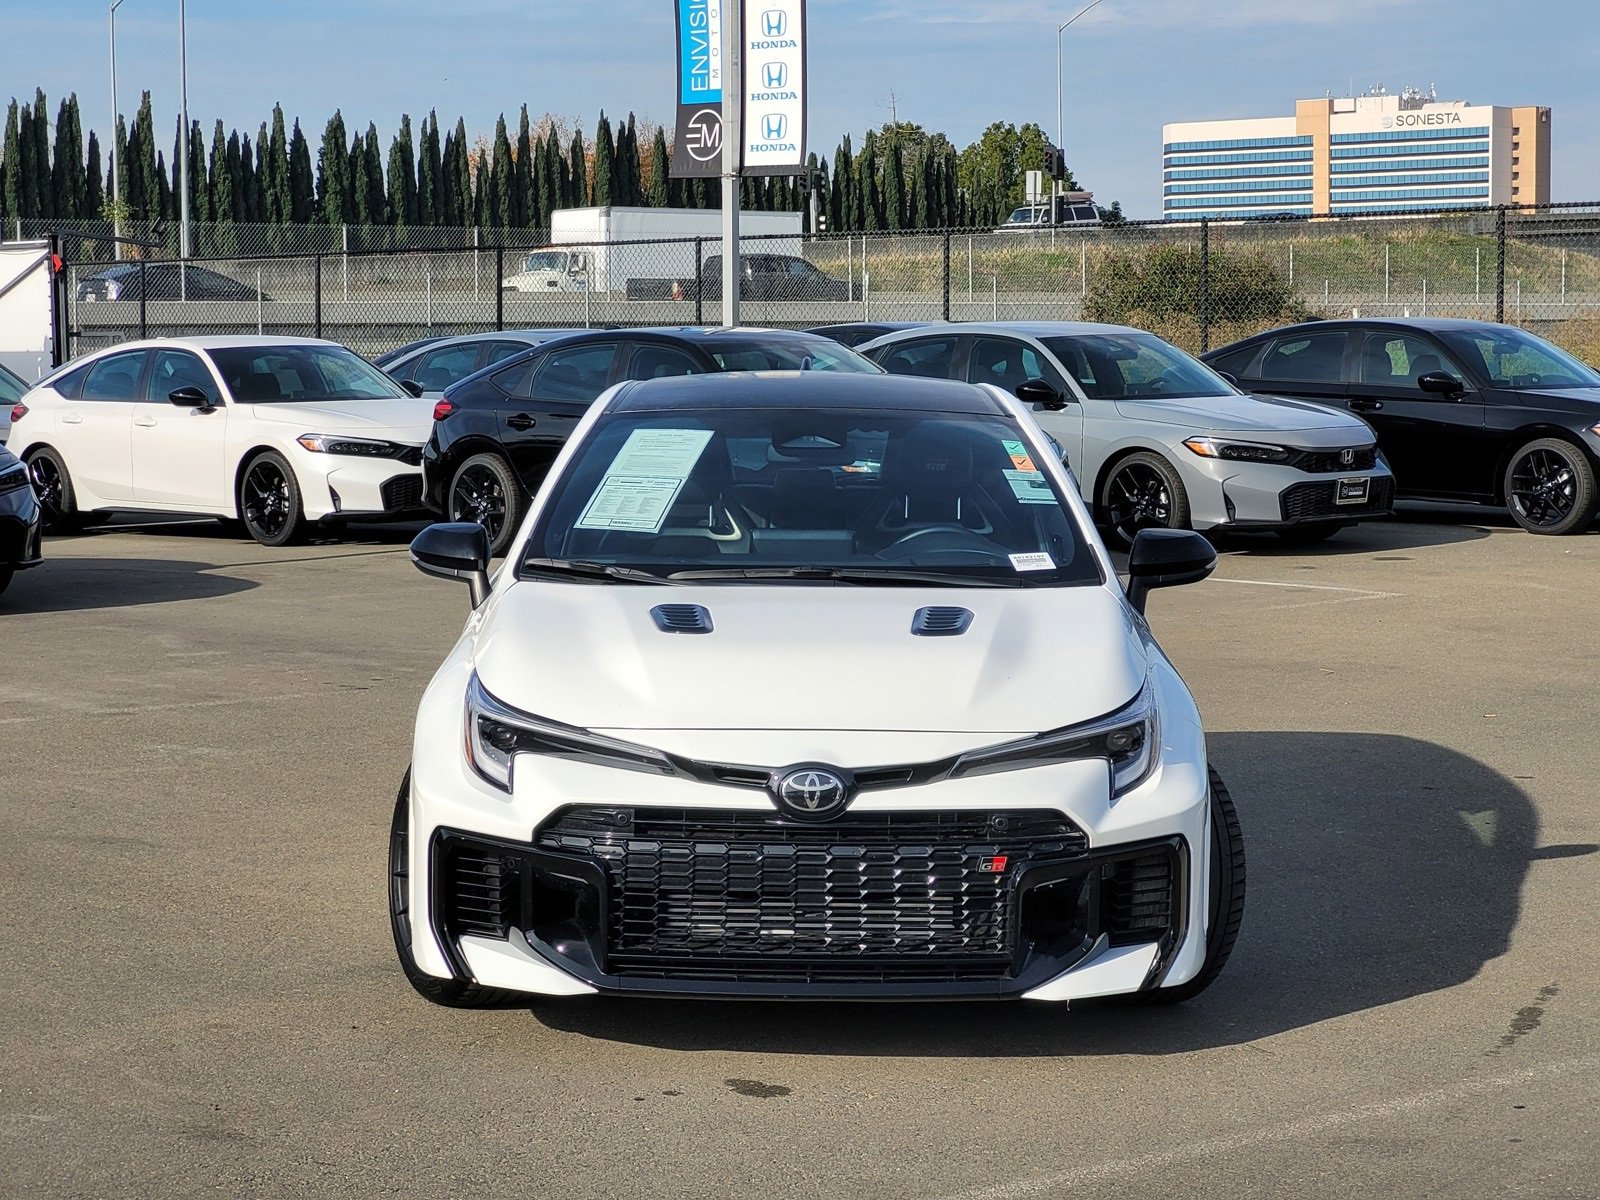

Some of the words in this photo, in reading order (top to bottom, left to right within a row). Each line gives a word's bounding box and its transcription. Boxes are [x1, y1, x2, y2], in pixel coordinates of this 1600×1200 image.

[690, 0, 709, 92] ENVISI
[751, 40, 797, 50] HONDA
[751, 92, 798, 101] HONDA
[1396, 112, 1461, 126] SONESTA
[750, 143, 797, 152] HONDA
